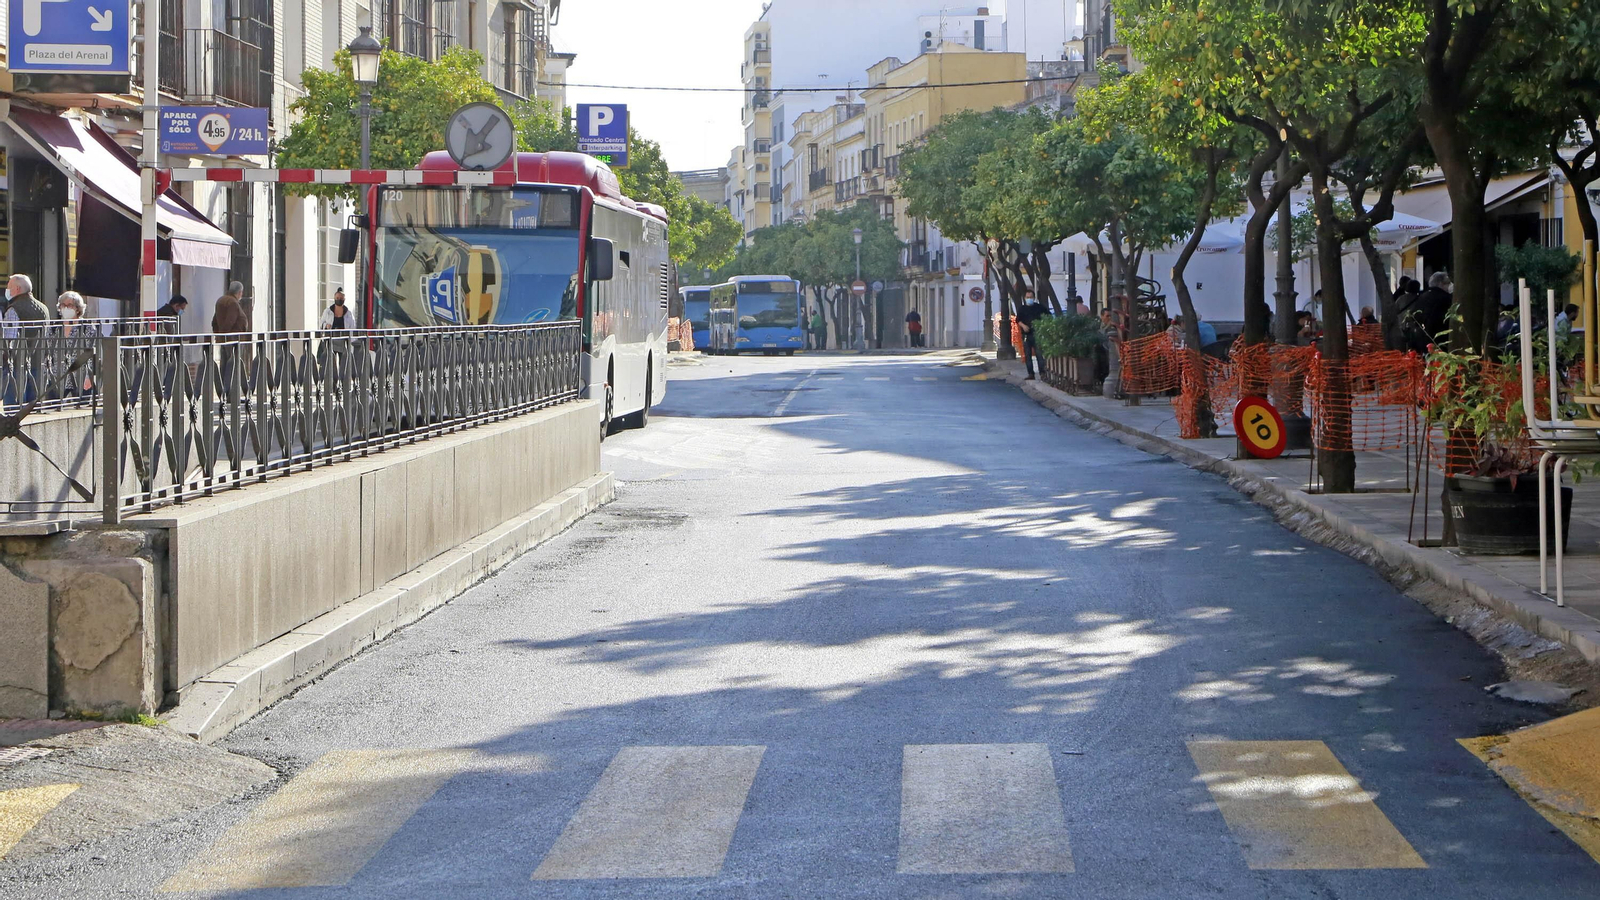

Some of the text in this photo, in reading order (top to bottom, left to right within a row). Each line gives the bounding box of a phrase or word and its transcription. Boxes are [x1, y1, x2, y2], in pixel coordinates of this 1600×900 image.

[28, 49, 109, 60] Plaza del Arenal
[589, 106, 614, 136] P
[169, 125, 191, 133] SÓLO
[239, 128, 253, 140] 24
[382, 190, 403, 201] 120
[1250, 412, 1272, 441] 10
